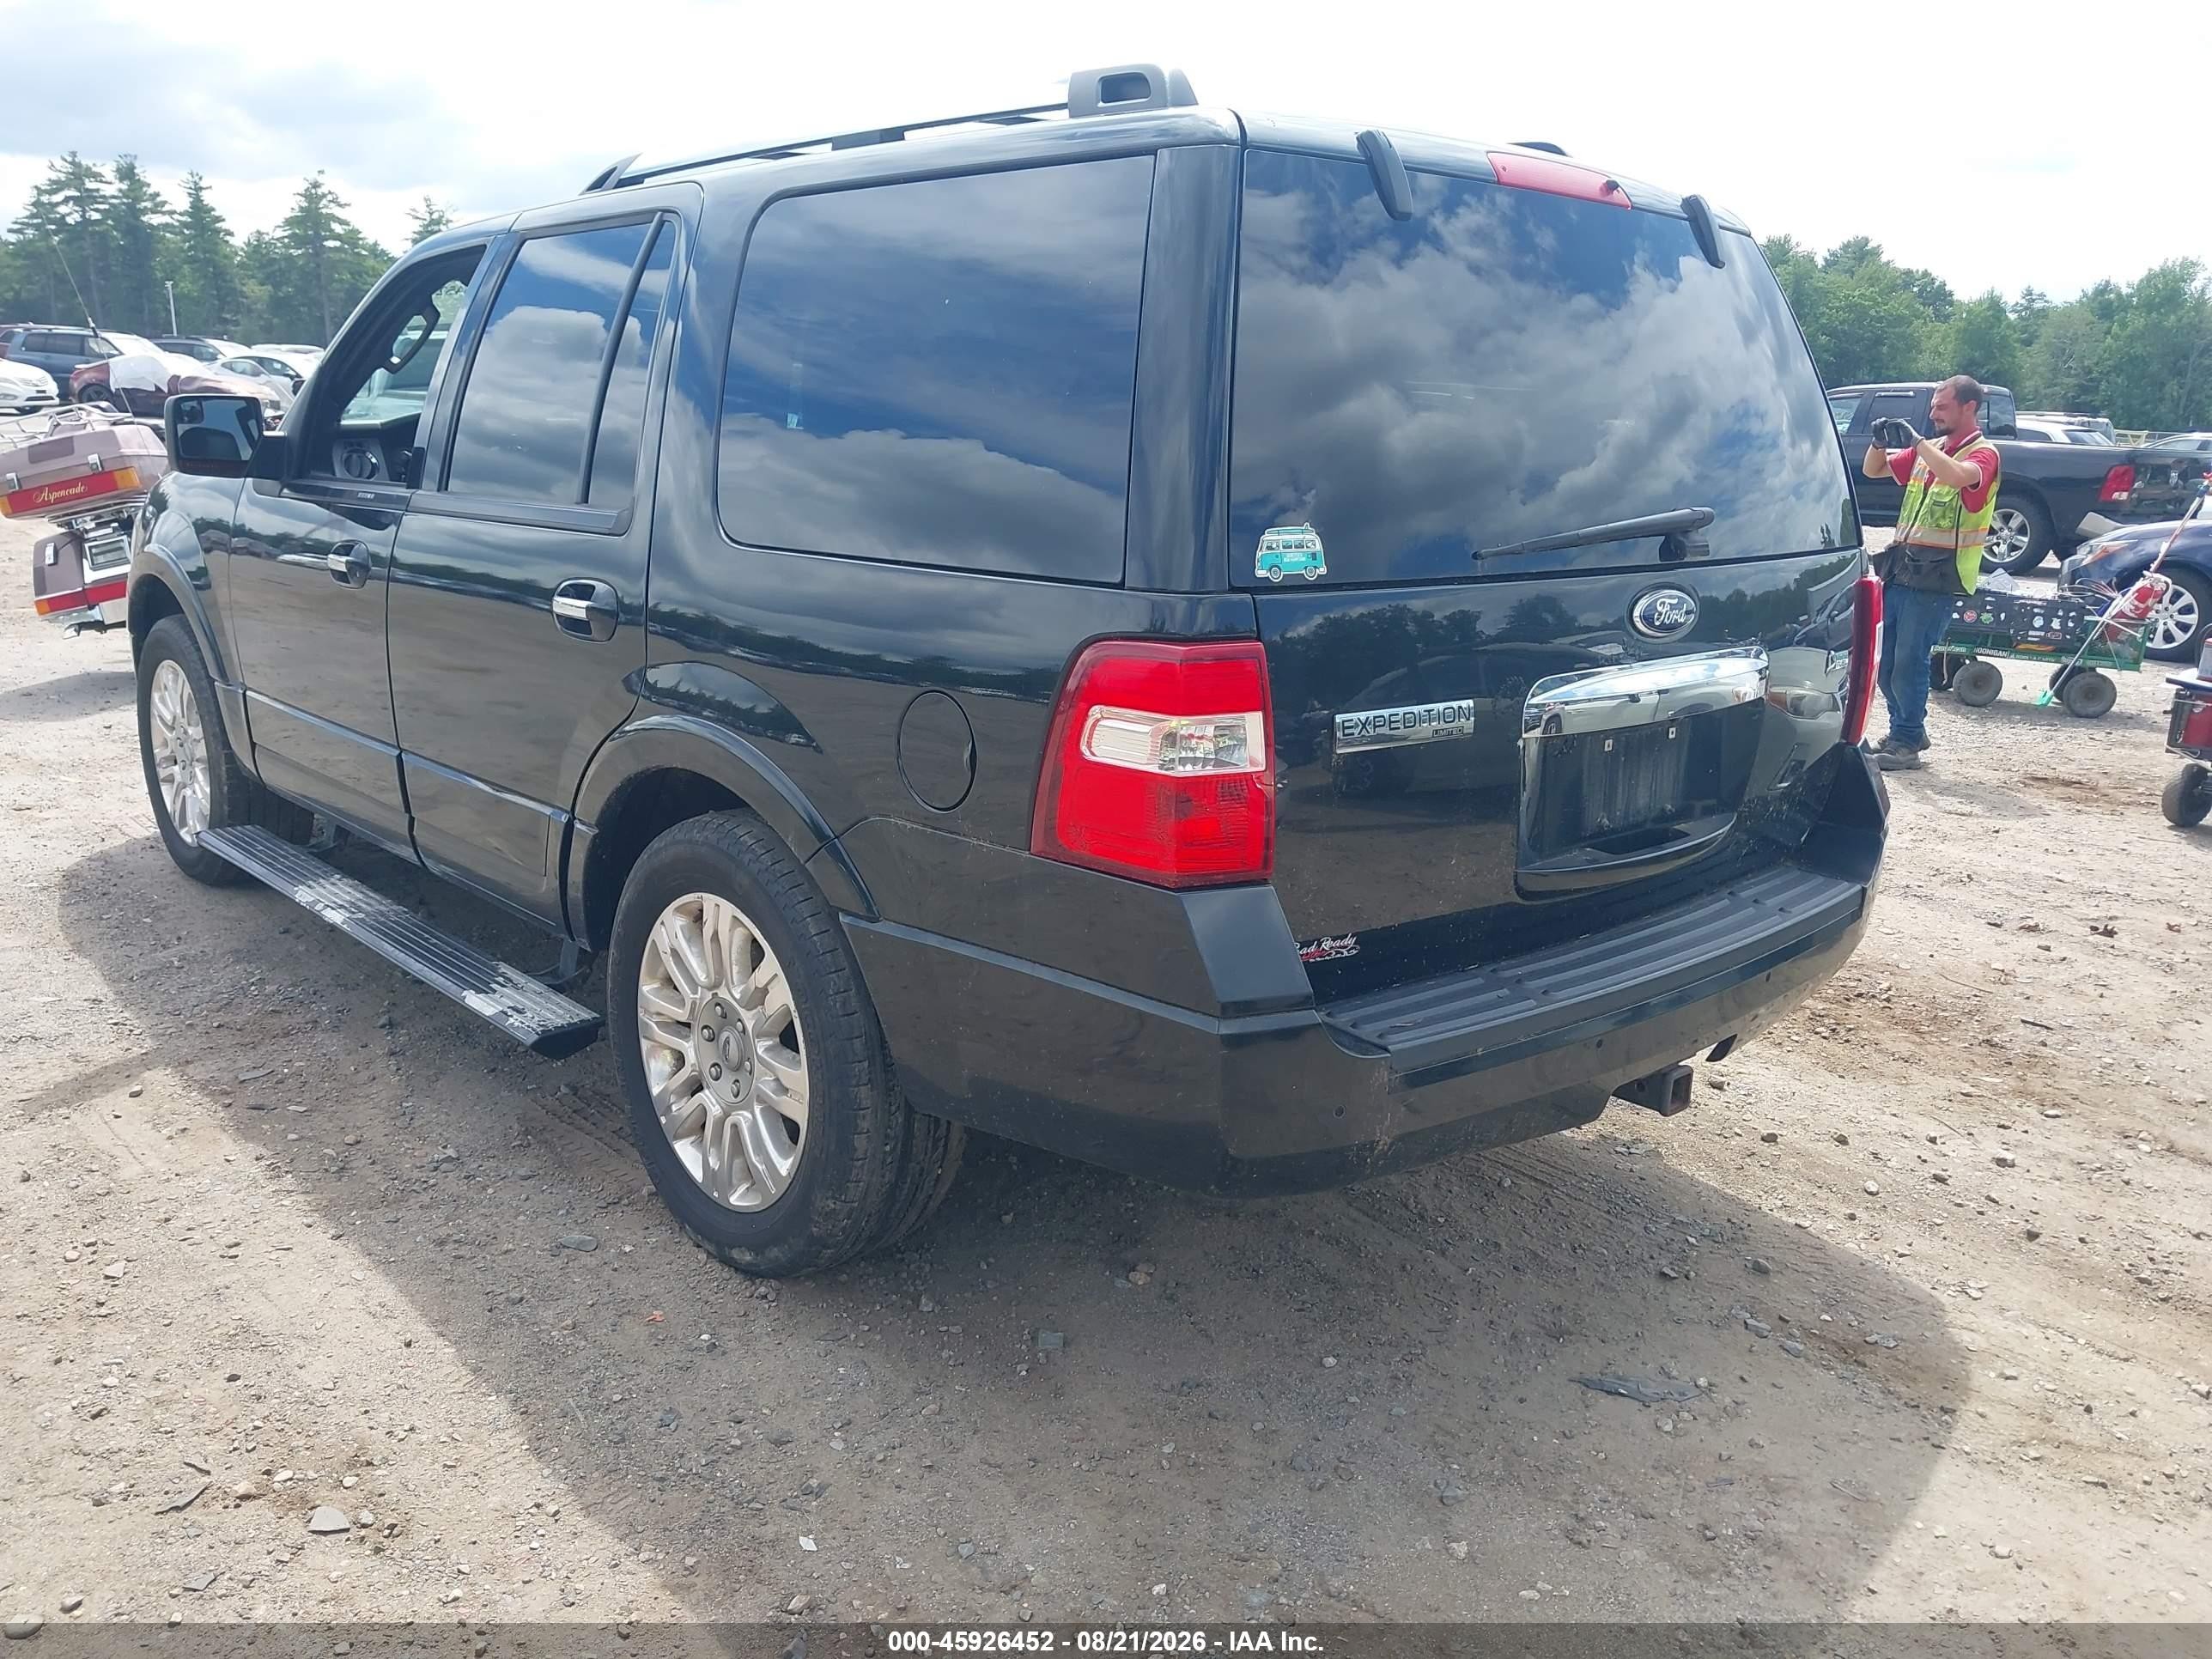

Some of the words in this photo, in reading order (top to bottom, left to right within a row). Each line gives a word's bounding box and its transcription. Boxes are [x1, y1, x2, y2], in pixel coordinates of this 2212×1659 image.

[33, 481, 88, 504] Aspencade
[1654, 598, 1687, 626] Ford
[1341, 704, 1472, 738] EXPEDITION
[1433, 726, 1464, 738] LIMITED
[1320, 933, 1358, 951] Ready
